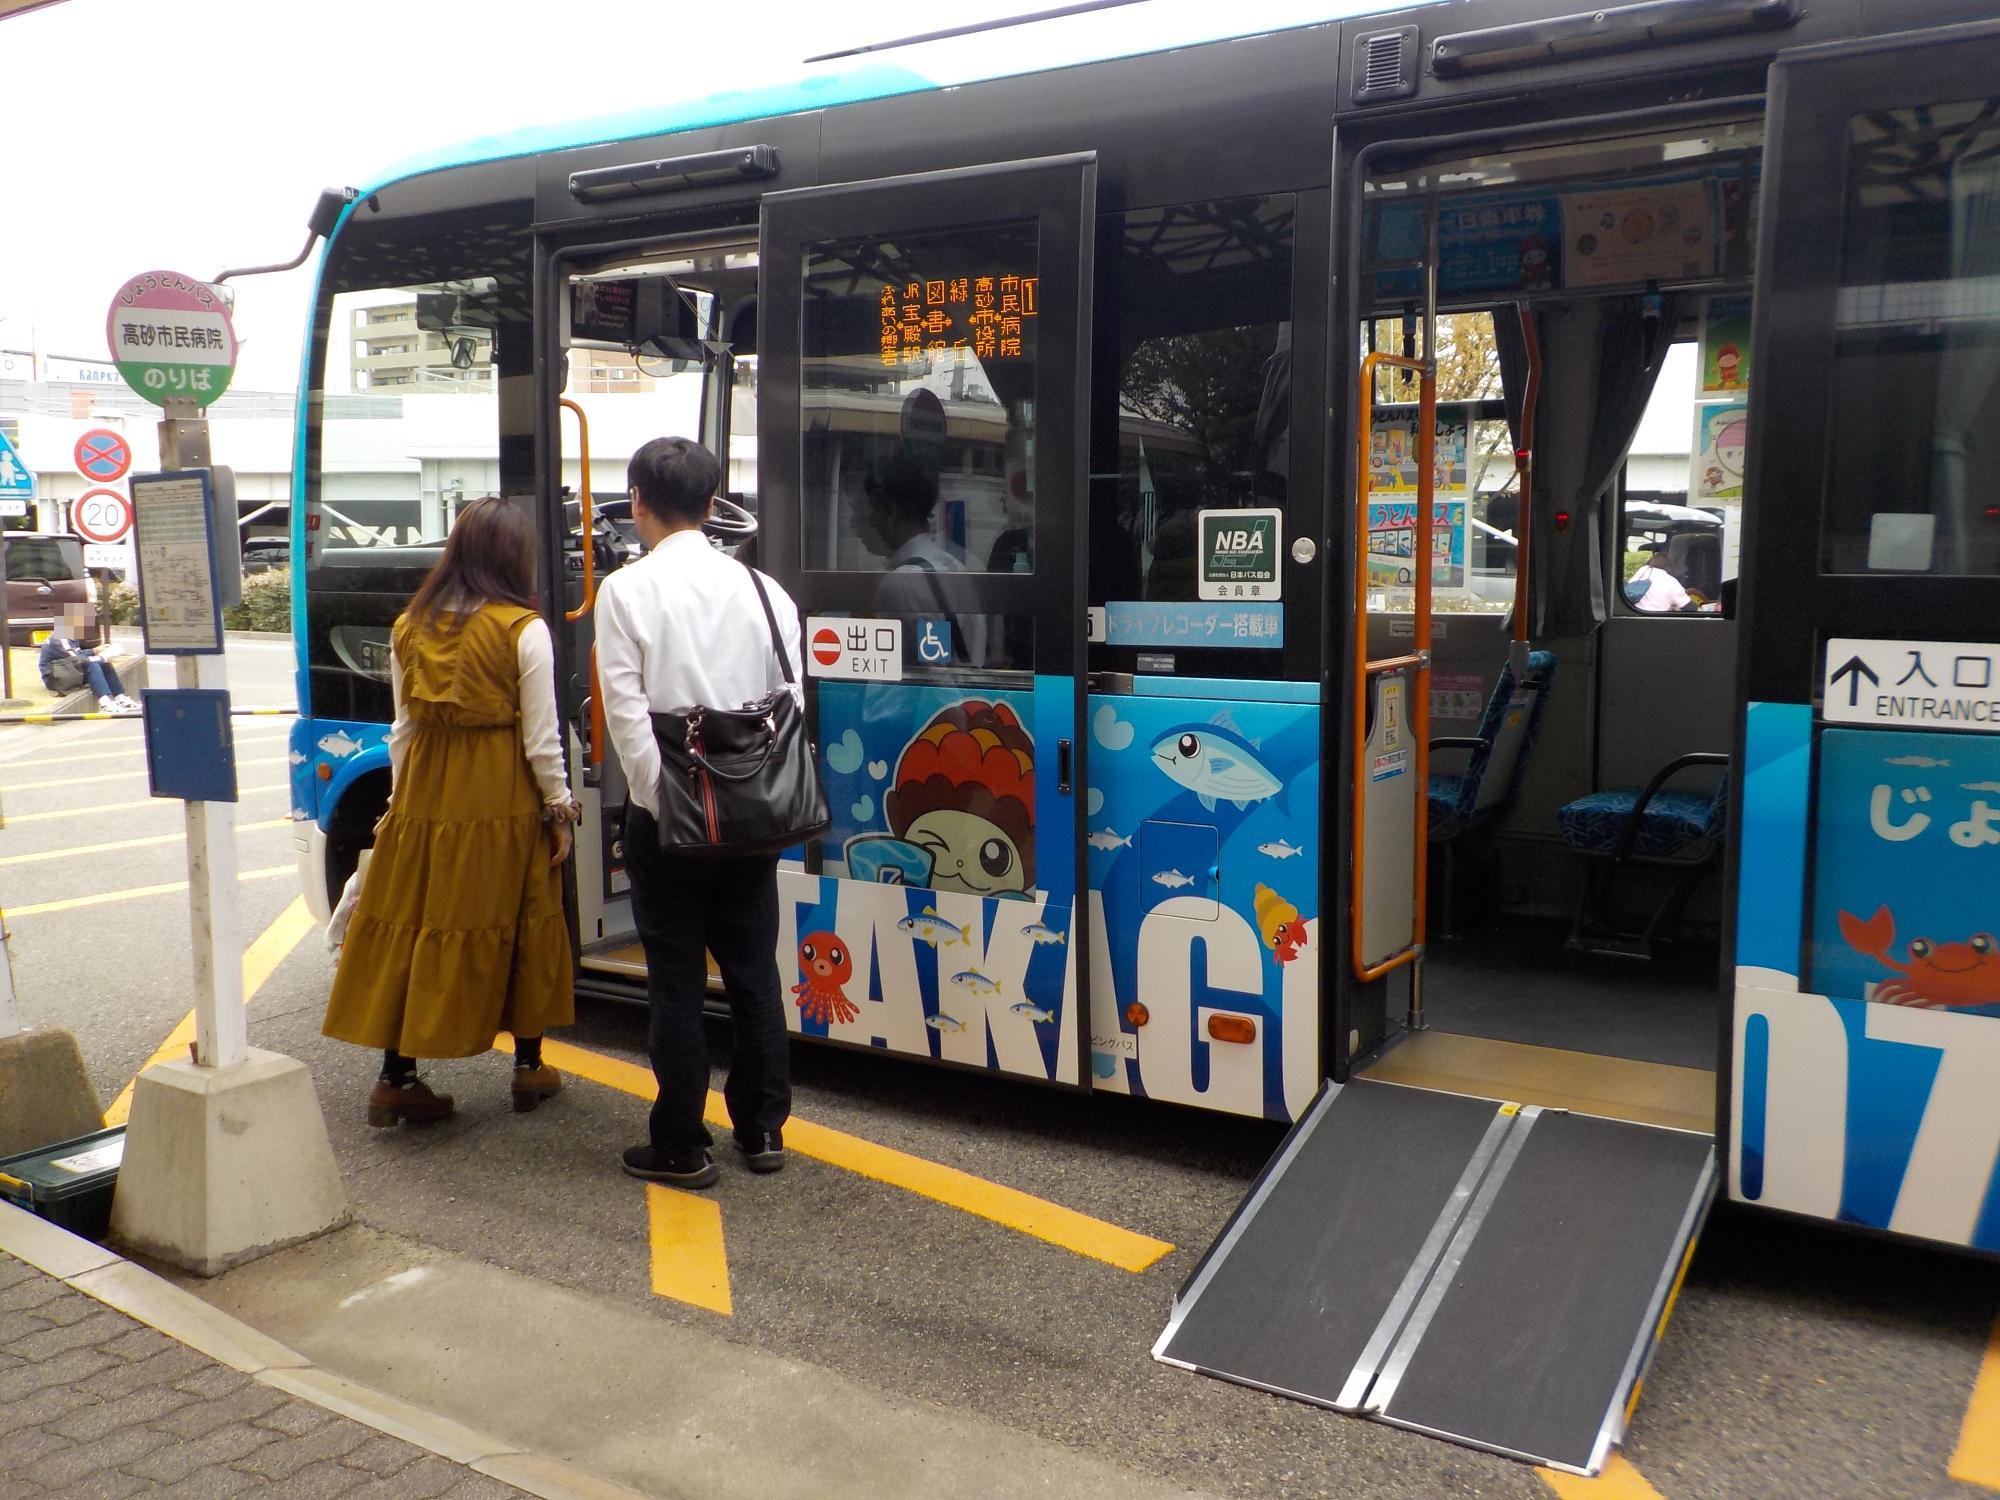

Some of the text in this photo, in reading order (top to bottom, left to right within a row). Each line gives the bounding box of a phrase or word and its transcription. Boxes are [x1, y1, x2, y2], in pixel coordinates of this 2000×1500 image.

[121, 276, 214, 309] じょうとんバス
[902, 282, 922, 363] JR宝殿駅
[926, 280, 946, 363] 図書館
[974, 276, 996, 359] 高砂市役所
[999, 273, 1021, 356] 市民病院
[121, 323, 224, 350] 高砂市民病院
[144, 367, 212, 391] のりば
[87, 503, 119, 527] 20
[1214, 530, 1264, 550] NBA
[1230, 570, 1271, 579] 日本バス協会
[1217, 585, 1261, 597] 会員章
[846, 625, 895, 651] 出口
[852, 658, 888, 673] EXIT
[1896, 651, 1992, 689] 入口
[1876, 695, 2000, 723] ENTRANCE
